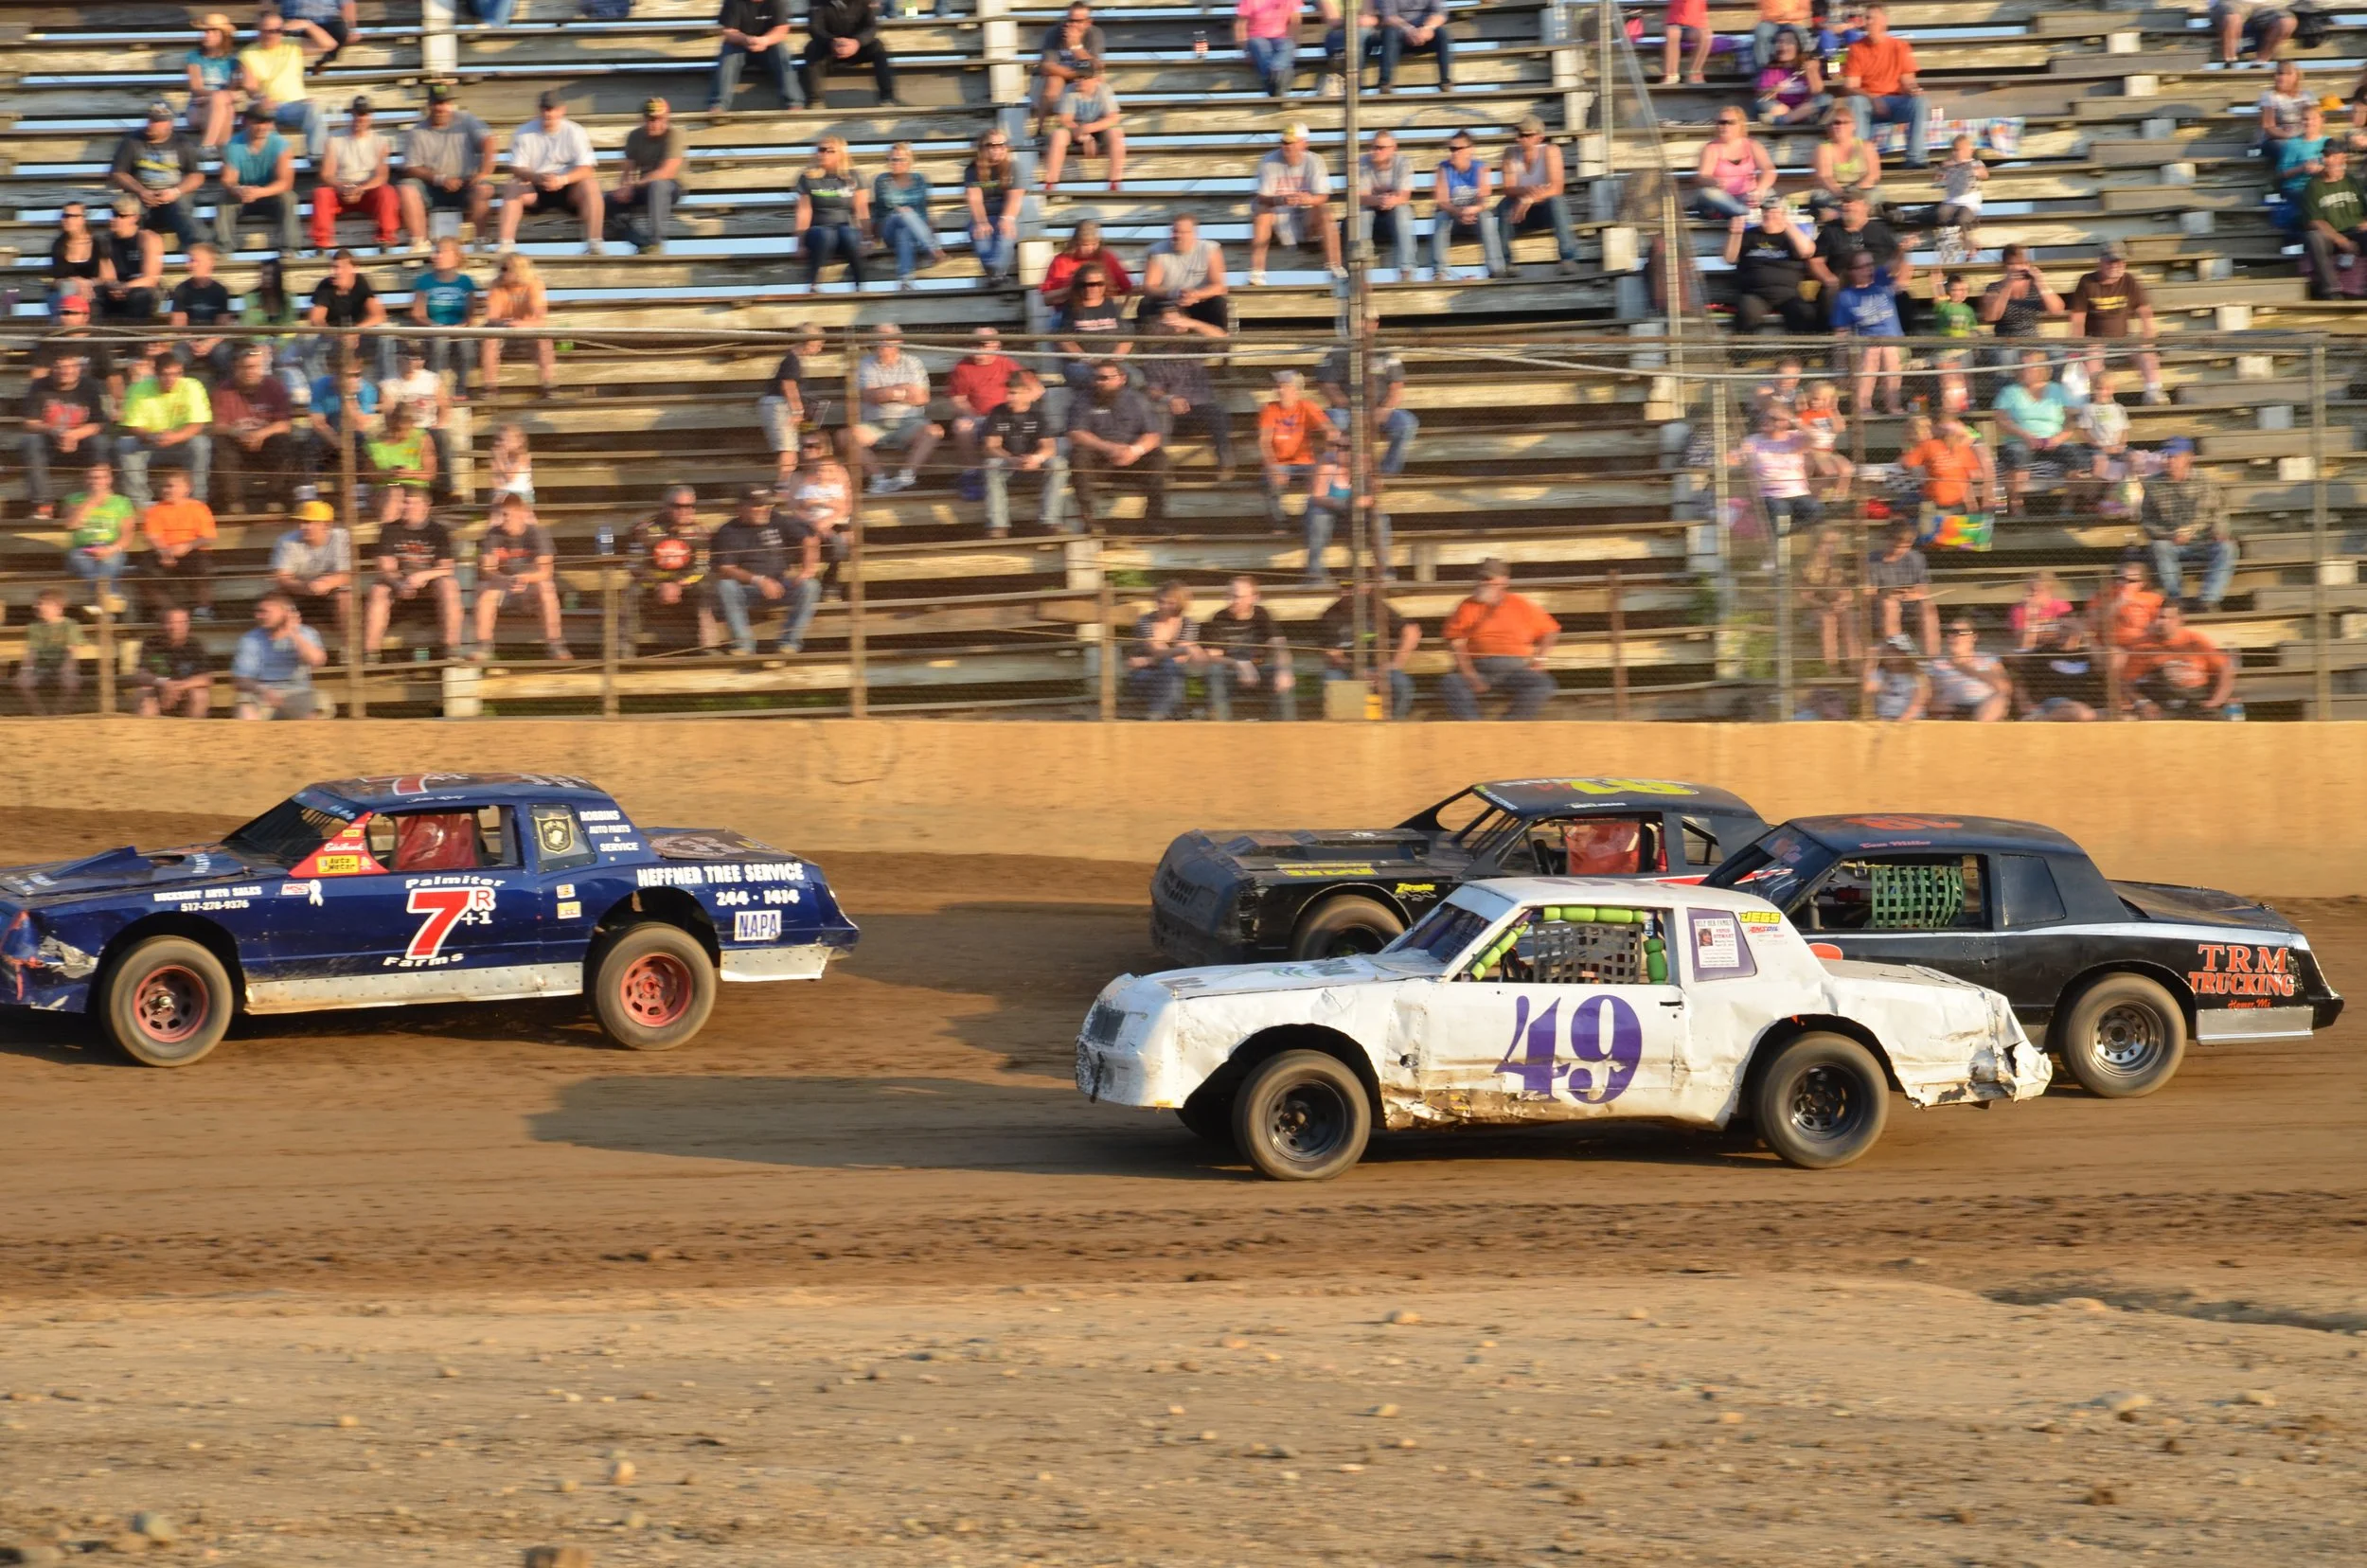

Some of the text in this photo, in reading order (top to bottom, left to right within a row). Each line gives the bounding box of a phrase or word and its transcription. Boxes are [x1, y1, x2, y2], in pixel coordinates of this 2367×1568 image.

[599, 842, 639, 852] SERVICE
[405, 876, 507, 889] Palmiter
[636, 863, 805, 887] HEFFNER TREE SERVICE
[205, 888, 230, 898] AUTO
[232, 886, 262, 896] SALES
[716, 889, 800, 906] 244 1414
[739, 914, 779, 937] NAPA
[1738, 911, 1781, 924] JEGS
[383, 953, 465, 968] Farms
[2198, 944, 2288, 973] TRM
[2188, 971, 2294, 997] TRUCKING
[1493, 994, 1643, 1105] 49
